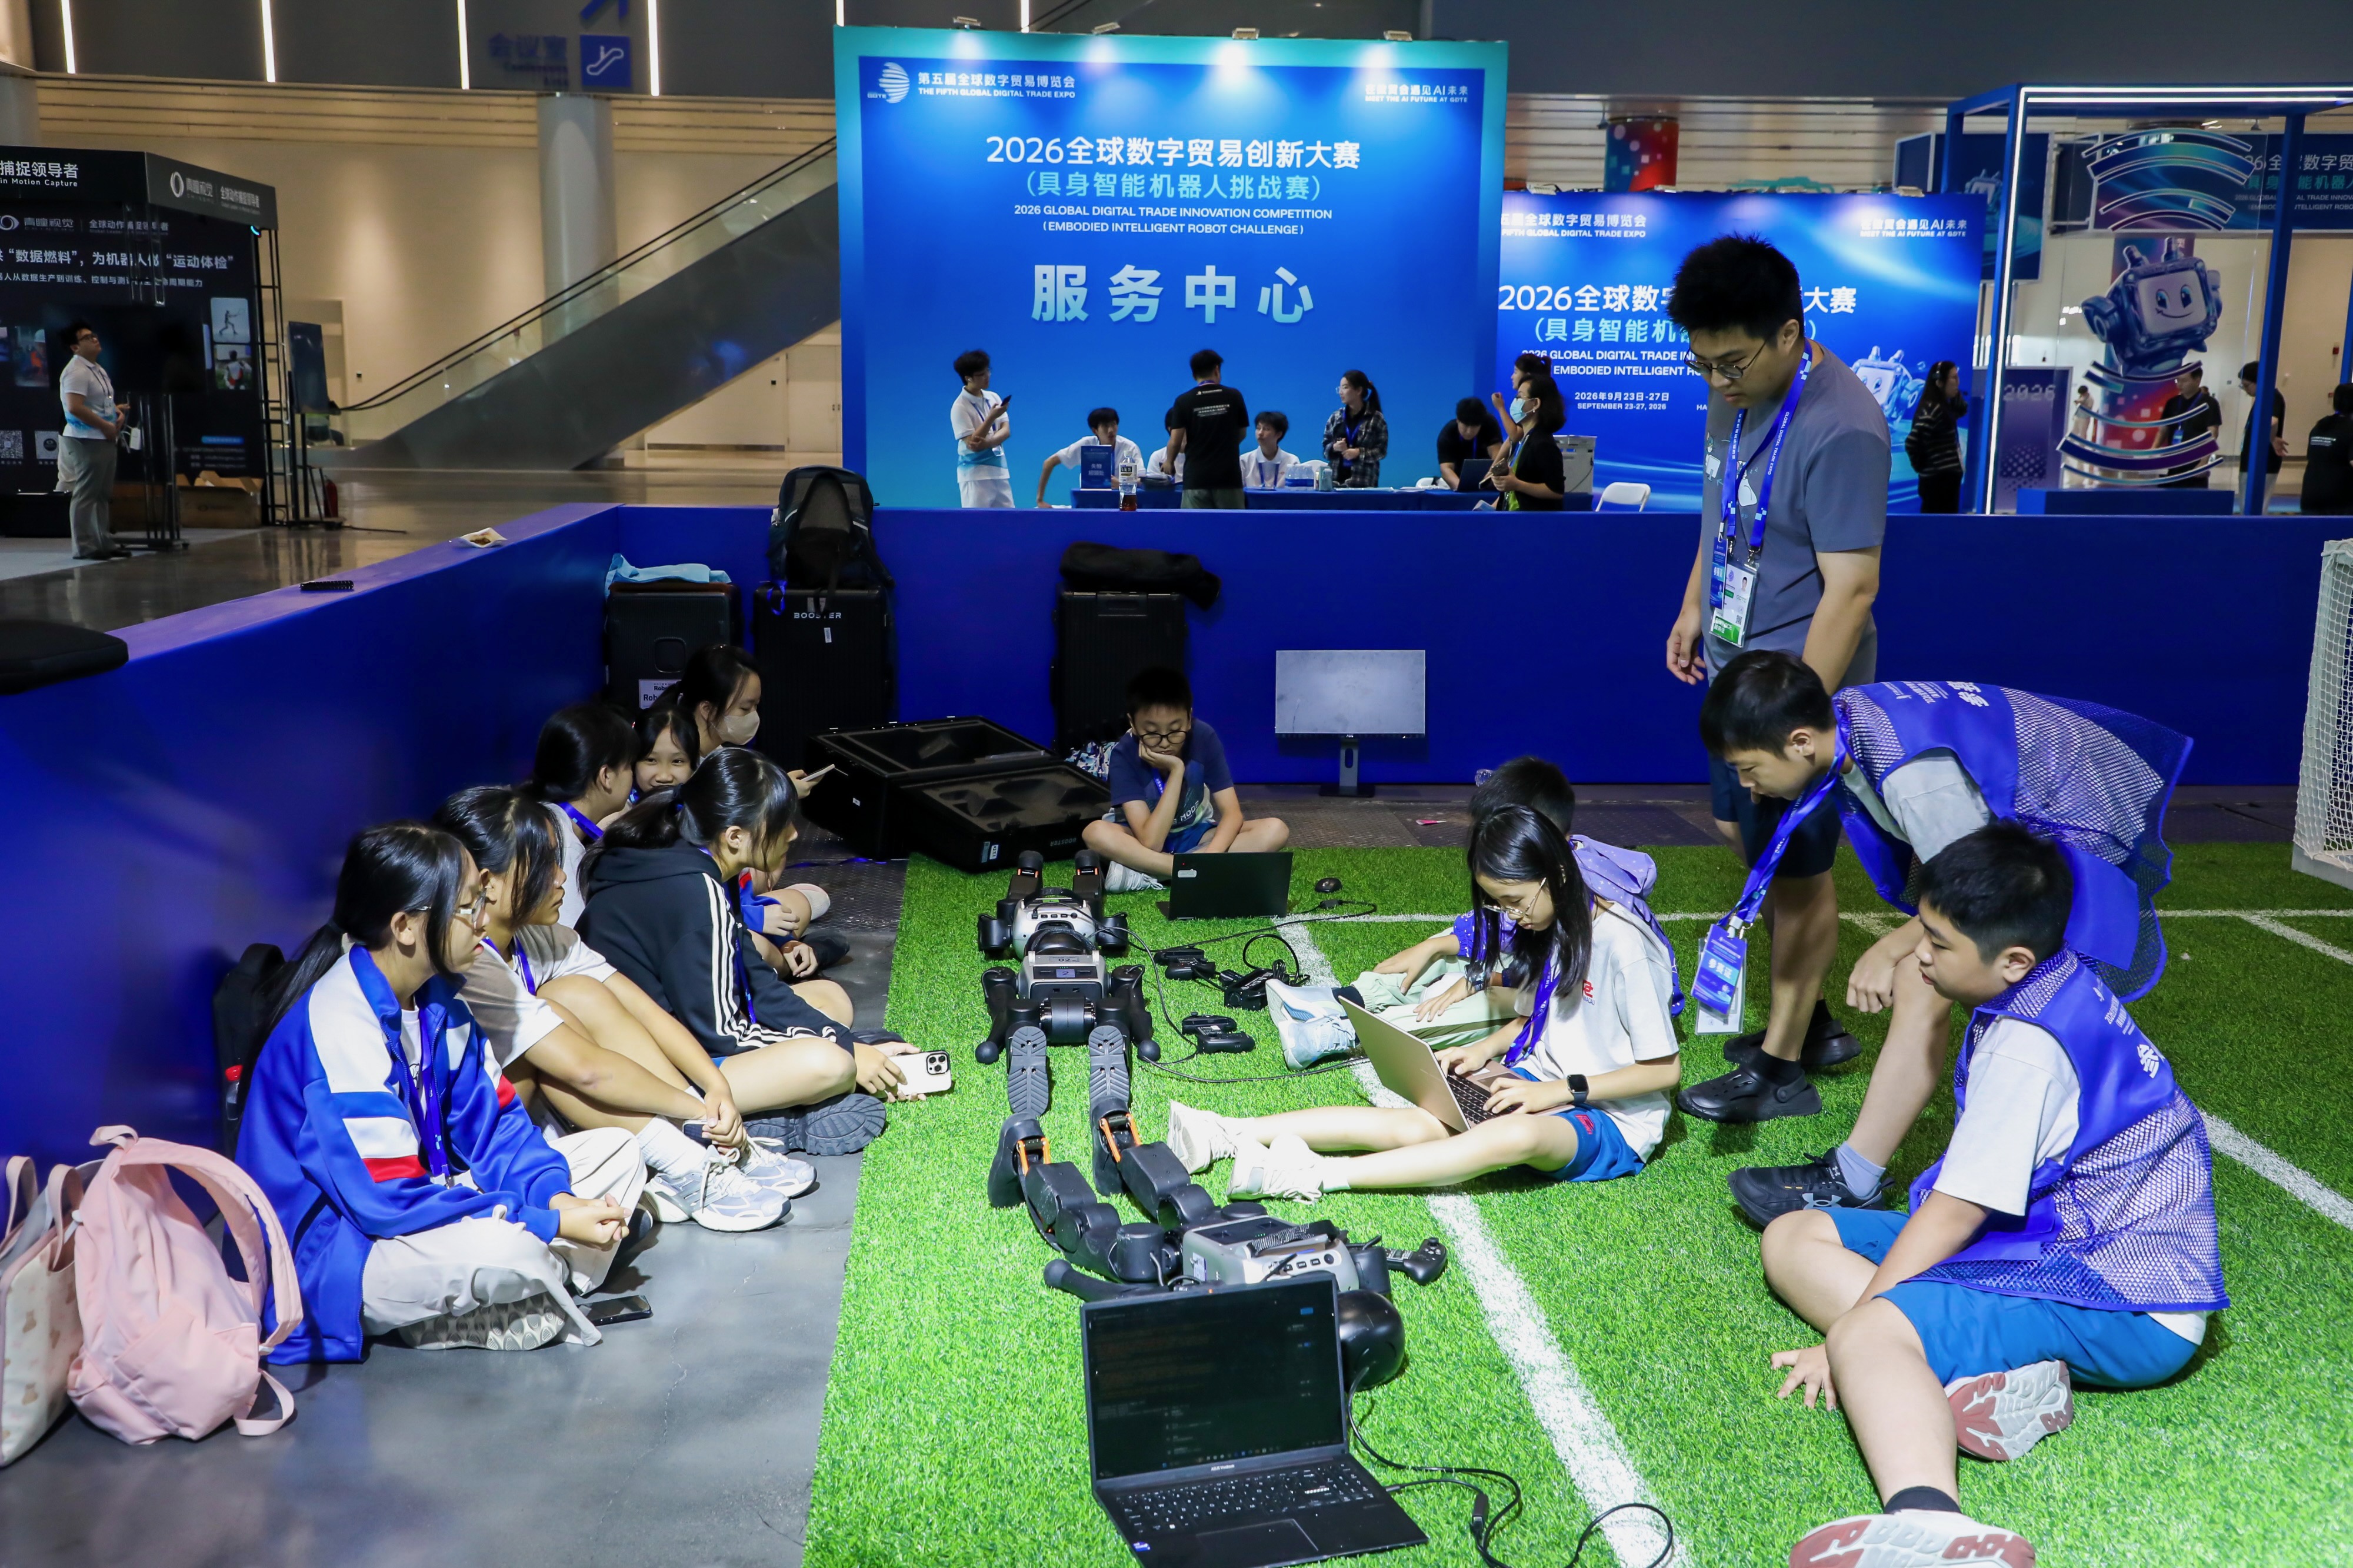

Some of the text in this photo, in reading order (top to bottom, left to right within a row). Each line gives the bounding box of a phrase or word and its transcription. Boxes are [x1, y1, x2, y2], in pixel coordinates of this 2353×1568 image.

[918, 71, 1075, 88] 第五届全球数字贸易博览会
[986, 136, 1361, 169] 2026全球数字贸易创新大赛
[0, 160, 78, 179] 捕捉领导者
[45, 179, 78, 188] Capture
[1026, 171, 1321, 201] （具身智能机器人挑战赛）
[1014, 205, 1332, 219] 2026 GLOBAL DIGITAL TRADE INNOVATION COMPETITION
[1043, 221, 1304, 235] (EMBODIED INTELLIGENT ROBOT CHALLENGE)
[1031, 264, 1315, 324] 服务中心
[1550, 351, 1594, 361] GLOBAL
[1596, 351, 1638, 361] DIGITAL
[1640, 351, 1678, 361] TRADE
[1554, 366, 1612, 376] EMBODIED
[1614, 366, 1684, 376] INTELLIGENT
[1575, 392, 1669, 402] 2026年9月23日-27日
[1781, 411, 1790, 429] GLOBAL
[1775, 429, 1784, 446] DIGITAL
